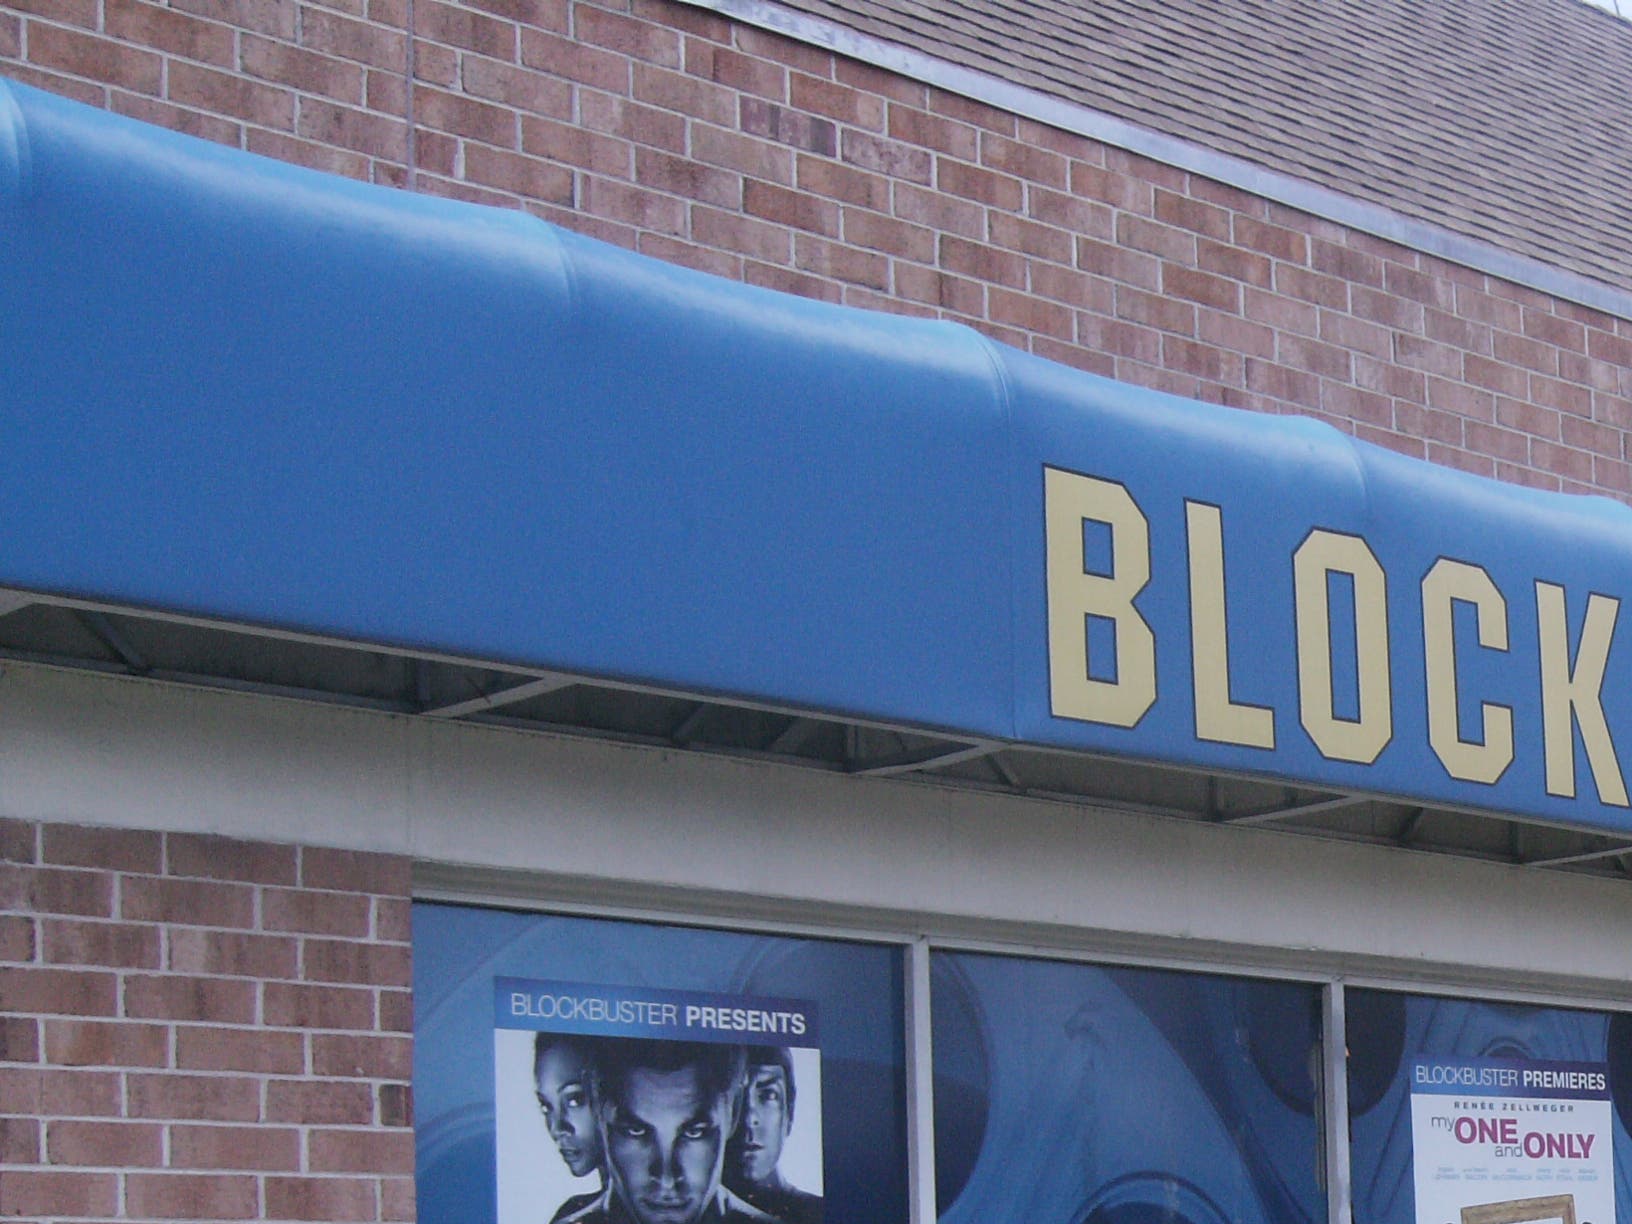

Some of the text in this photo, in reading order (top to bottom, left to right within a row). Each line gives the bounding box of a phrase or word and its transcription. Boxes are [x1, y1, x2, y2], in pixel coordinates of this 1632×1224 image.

[510, 992, 806, 1035] BLOCKBUSTER PRESENTS
[1415, 1065, 1606, 1091] BLOCKBUSTER PREMIERES
[1502, 1103, 1575, 1113] ZELLWEGER
[1431, 1116, 1519, 1144] my ONE
[1495, 1131, 1595, 1159] and ONLY
